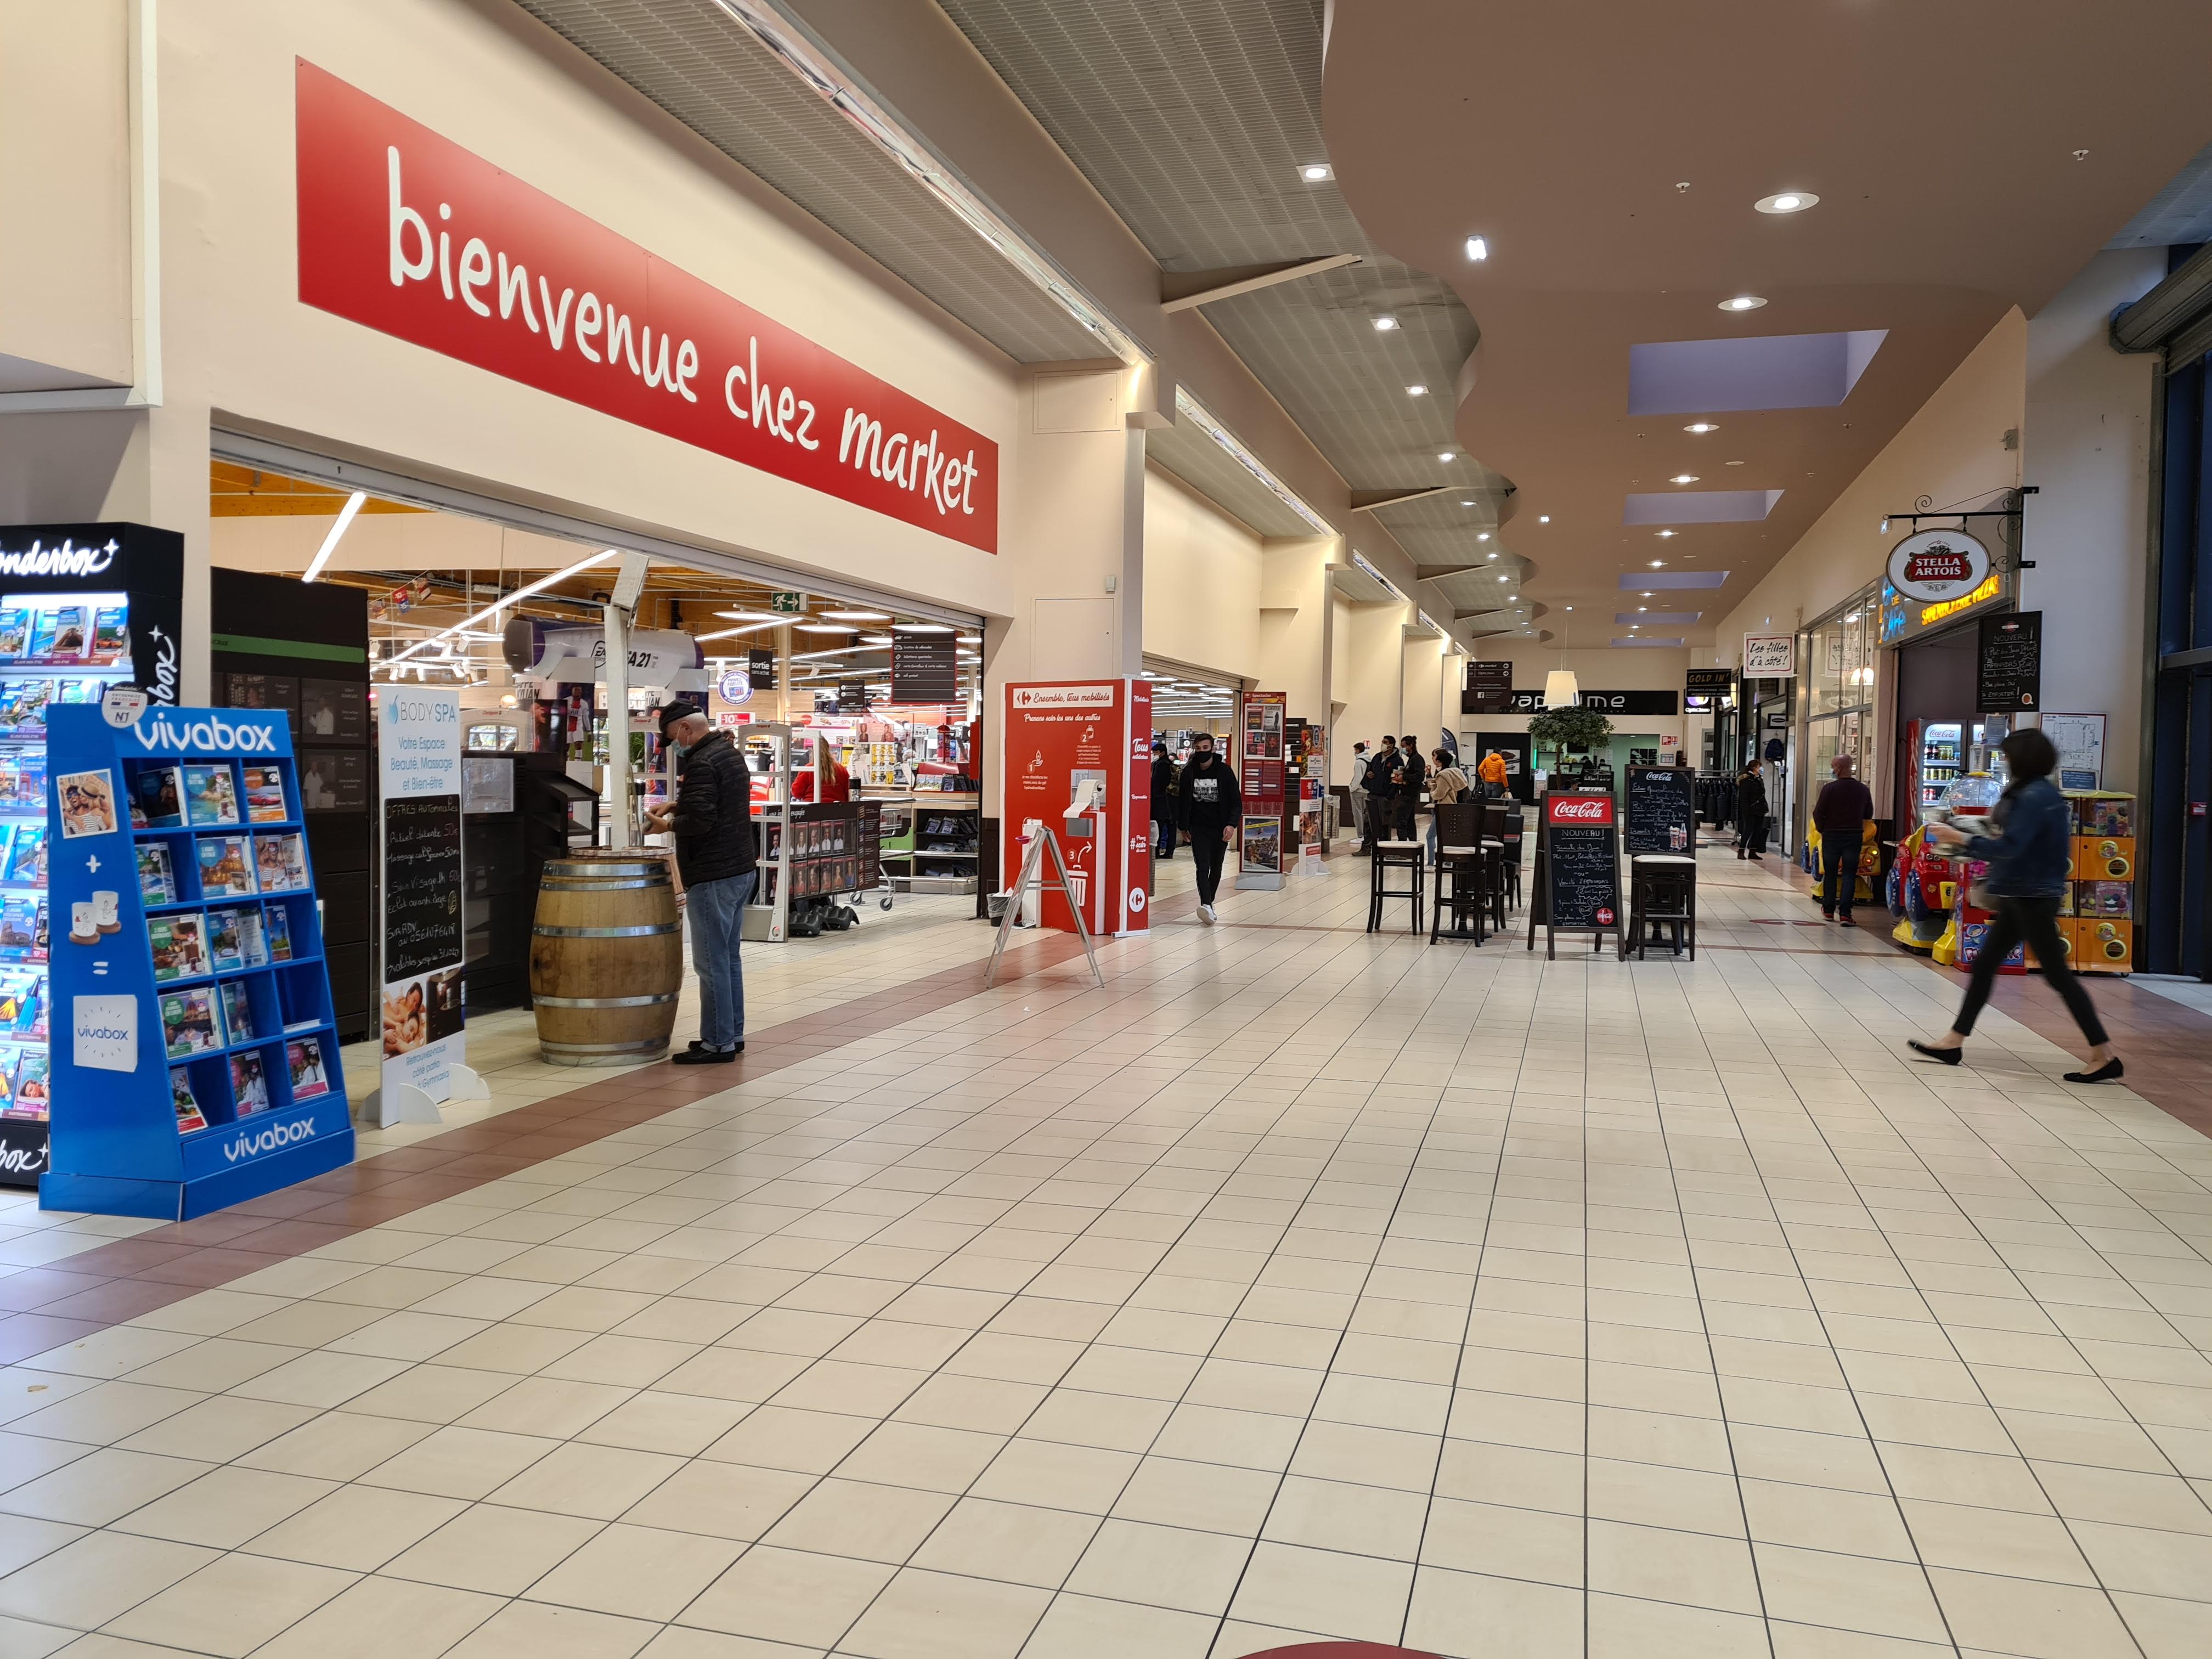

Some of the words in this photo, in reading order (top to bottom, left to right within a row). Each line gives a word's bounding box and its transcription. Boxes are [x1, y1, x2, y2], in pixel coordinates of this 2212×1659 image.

[388, 145, 698, 403] bienvenue
[725, 335, 820, 450] chez
[839, 407, 978, 516] market
[1915, 557, 1961, 567] STELLA
[1915, 567, 1961, 576] ARTOIS
[1972, 574, 2000, 603] PIZZAS
[1750, 642, 1765, 653] Les
[1767, 641, 1788, 654] filles
[751, 661, 770, 670] sortie
[1689, 674, 1712, 682] GOLD
[1033, 692, 1065, 703] Ensemble,
[1066, 692, 1079, 702] tous
[1081, 692, 1110, 702] mobilisés
[400, 702, 434, 721] BODY
[435, 703, 456, 723] SPA
[1024, 713, 1045, 723] Prenons
[1085, 713, 1101, 721] autres
[133, 712, 276, 752] vivabox
[1929, 729, 1957, 738] Coca-Cola
[398, 737, 417, 750] Votre
[419, 737, 445, 752] Espace
[1132, 738, 1149, 753] Tous
[391, 757, 420, 772] Beauté,
[420, 757, 453, 772] Massage
[1646, 771, 1674, 781] Coca-Cola
[403, 778, 411, 791] et
[411, 777, 443, 790] Bien-être
[386, 804, 416, 819] OFFRES
[1554, 801, 1606, 818] Coca-Cola
[77, 1024, 129, 1041] vivabox
[405, 1044, 447, 1066] Retrouvez-nous
[412, 1064, 425, 1079] côté
[223, 1116, 316, 1163] vivabox
